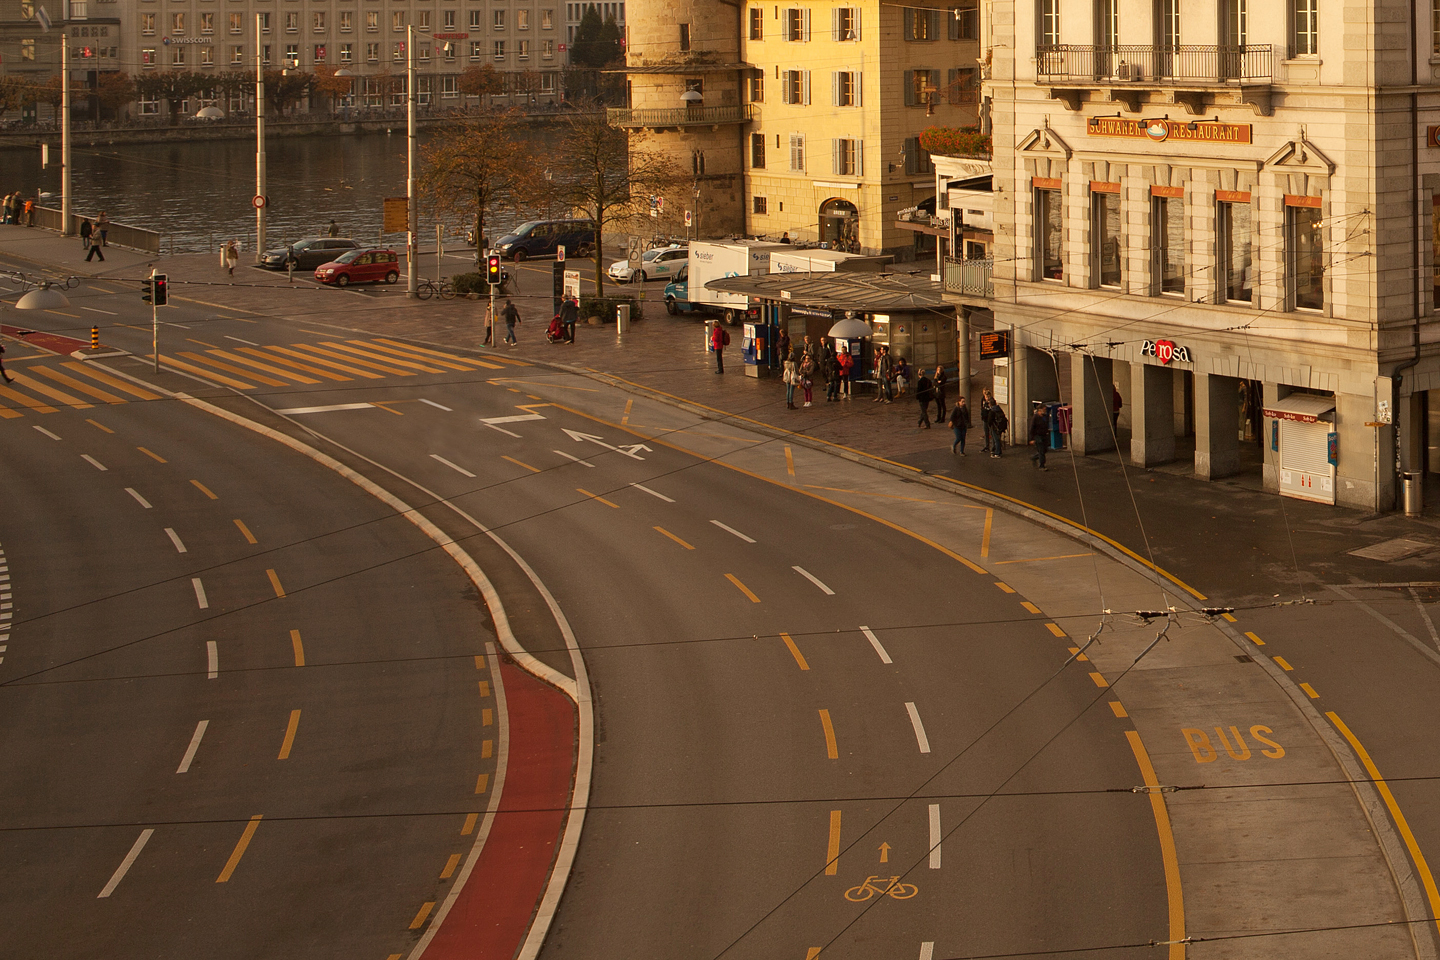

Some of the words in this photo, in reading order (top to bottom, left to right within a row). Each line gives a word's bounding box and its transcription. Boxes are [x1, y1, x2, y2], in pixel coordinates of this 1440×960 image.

[171, 35, 212, 44] swisscom
[699, 251, 714, 260] sieber
[1180, 724, 1286, 764] BUS
